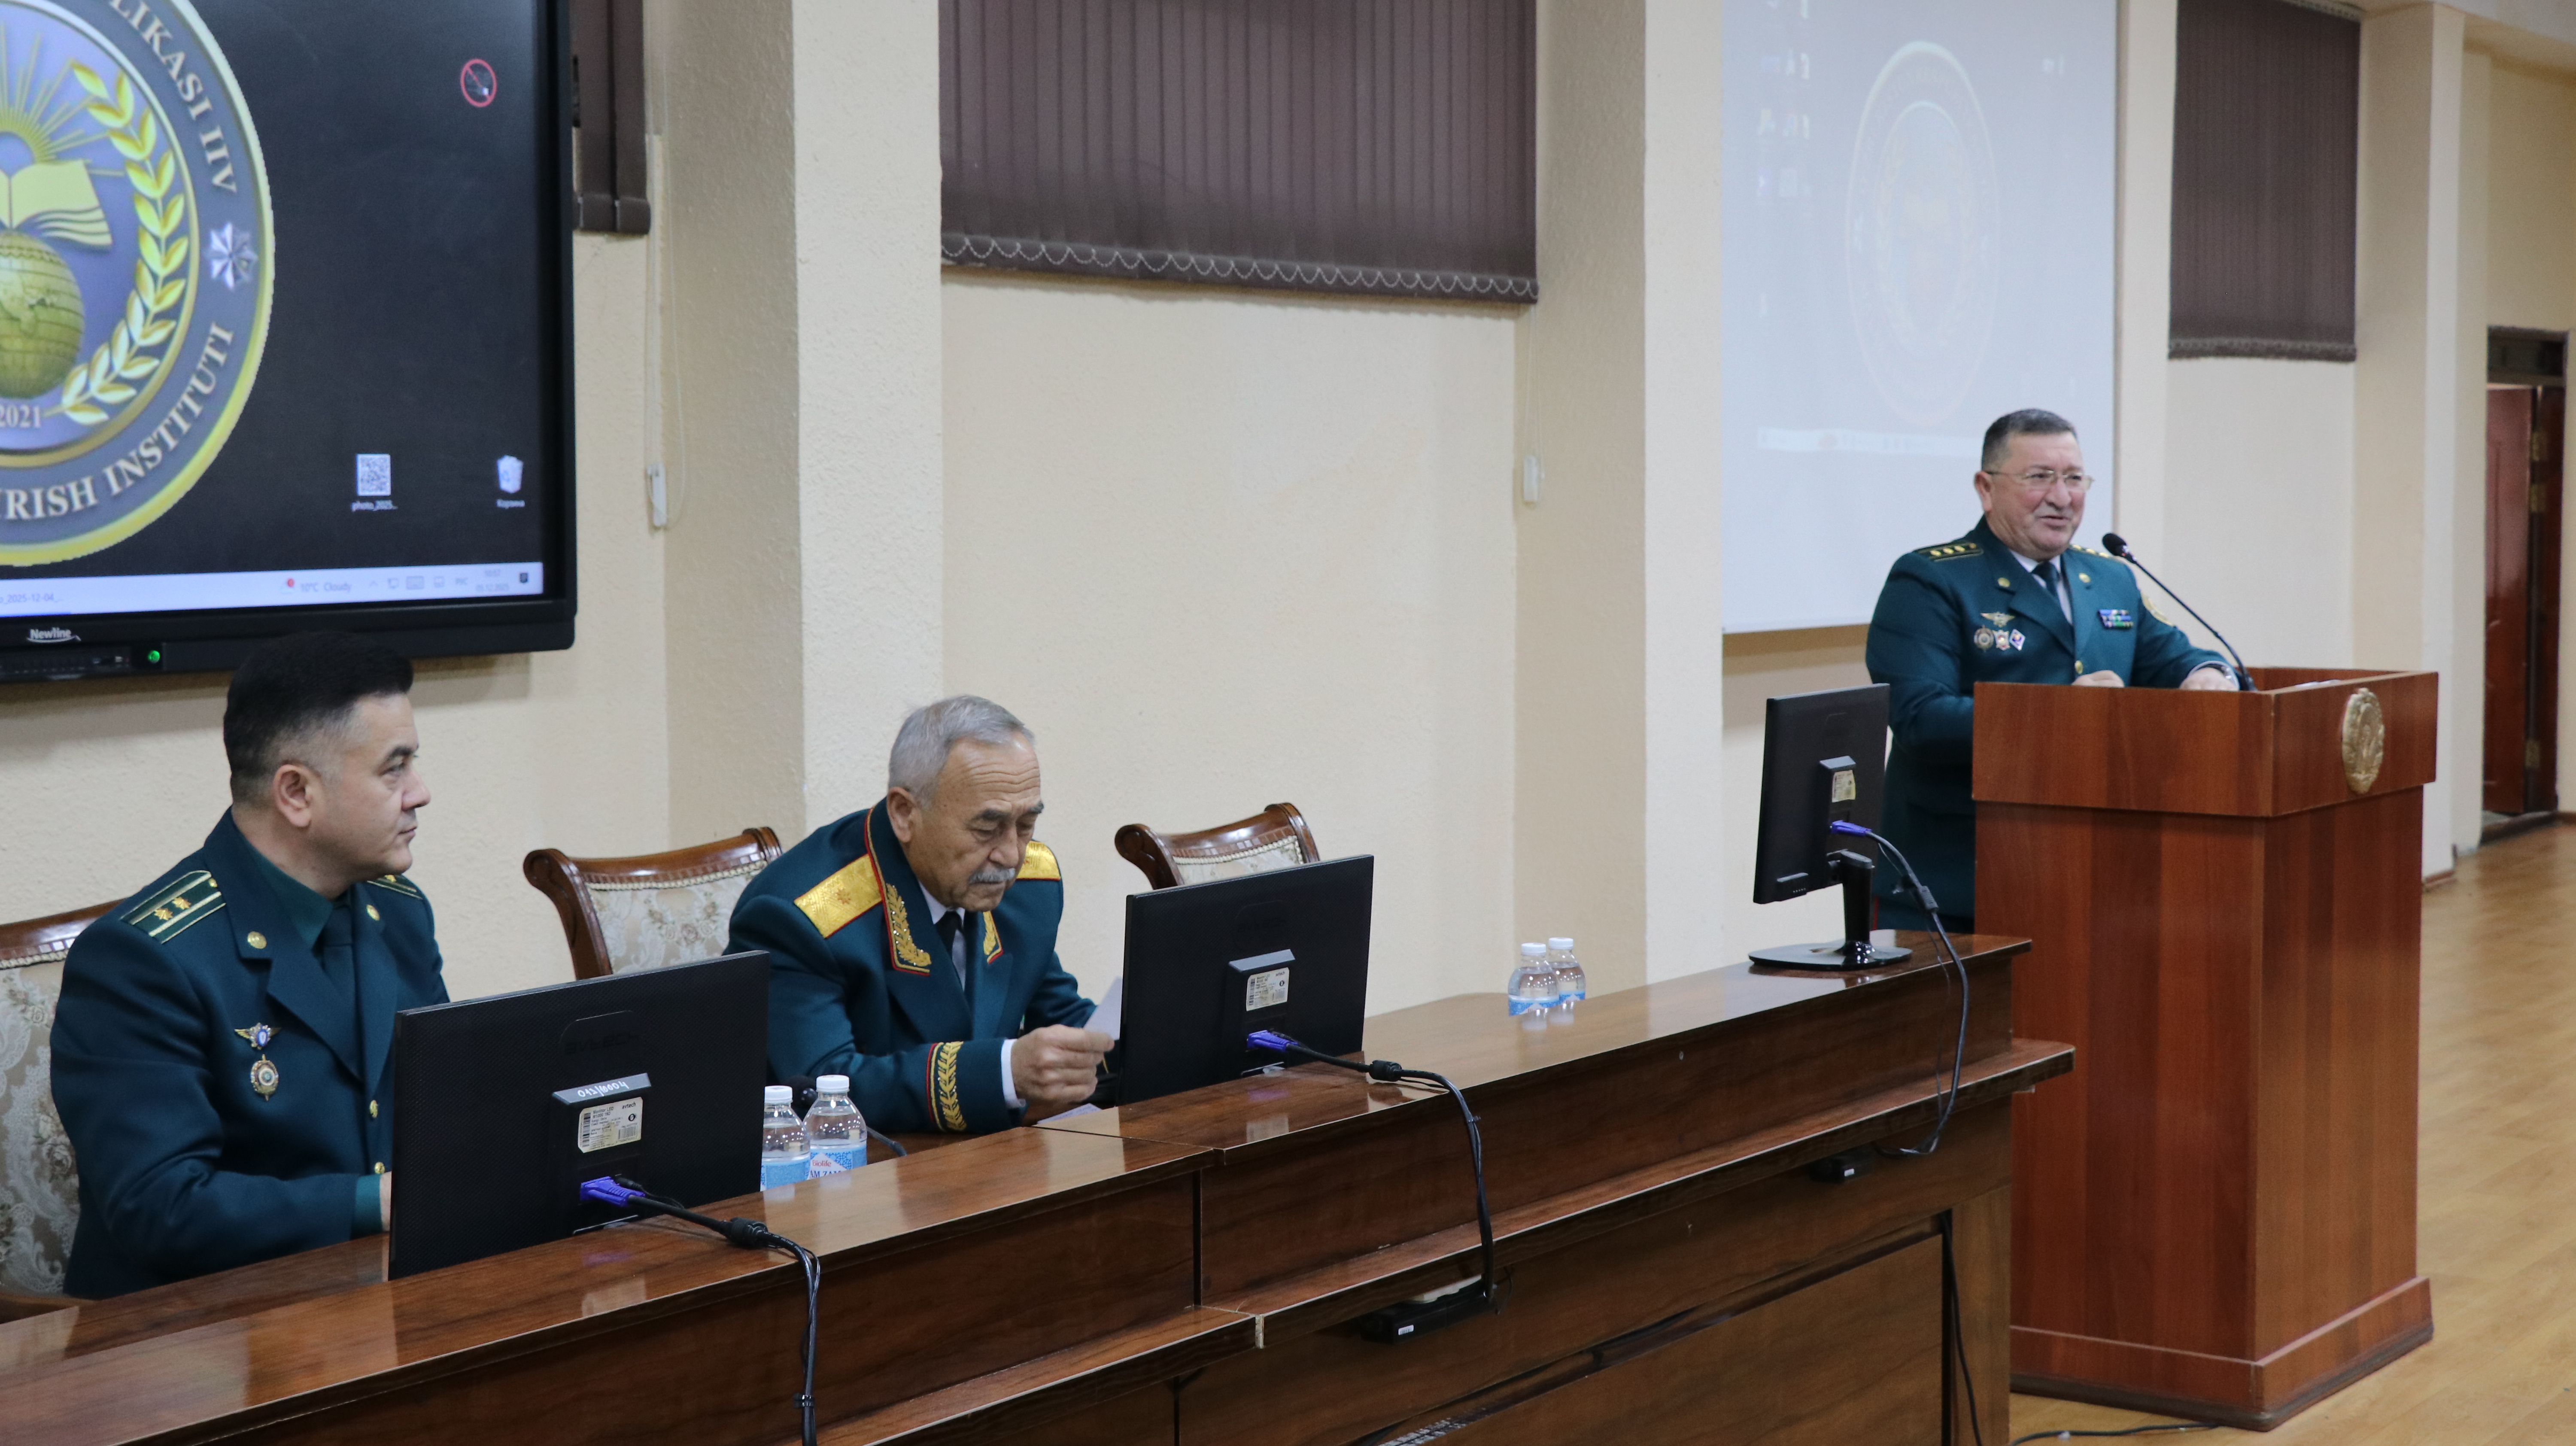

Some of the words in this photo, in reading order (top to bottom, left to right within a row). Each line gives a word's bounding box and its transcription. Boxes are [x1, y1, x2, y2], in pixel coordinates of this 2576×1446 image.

[199, 125, 237, 194] IIV
[0, 477, 98, 520] RISH
[102, 322, 235, 496] INSTITUTI
[323, 581, 352, 593] Cloudy
[30, 626, 72, 639] Newline
[622, 1101, 637, 1109] avtech
